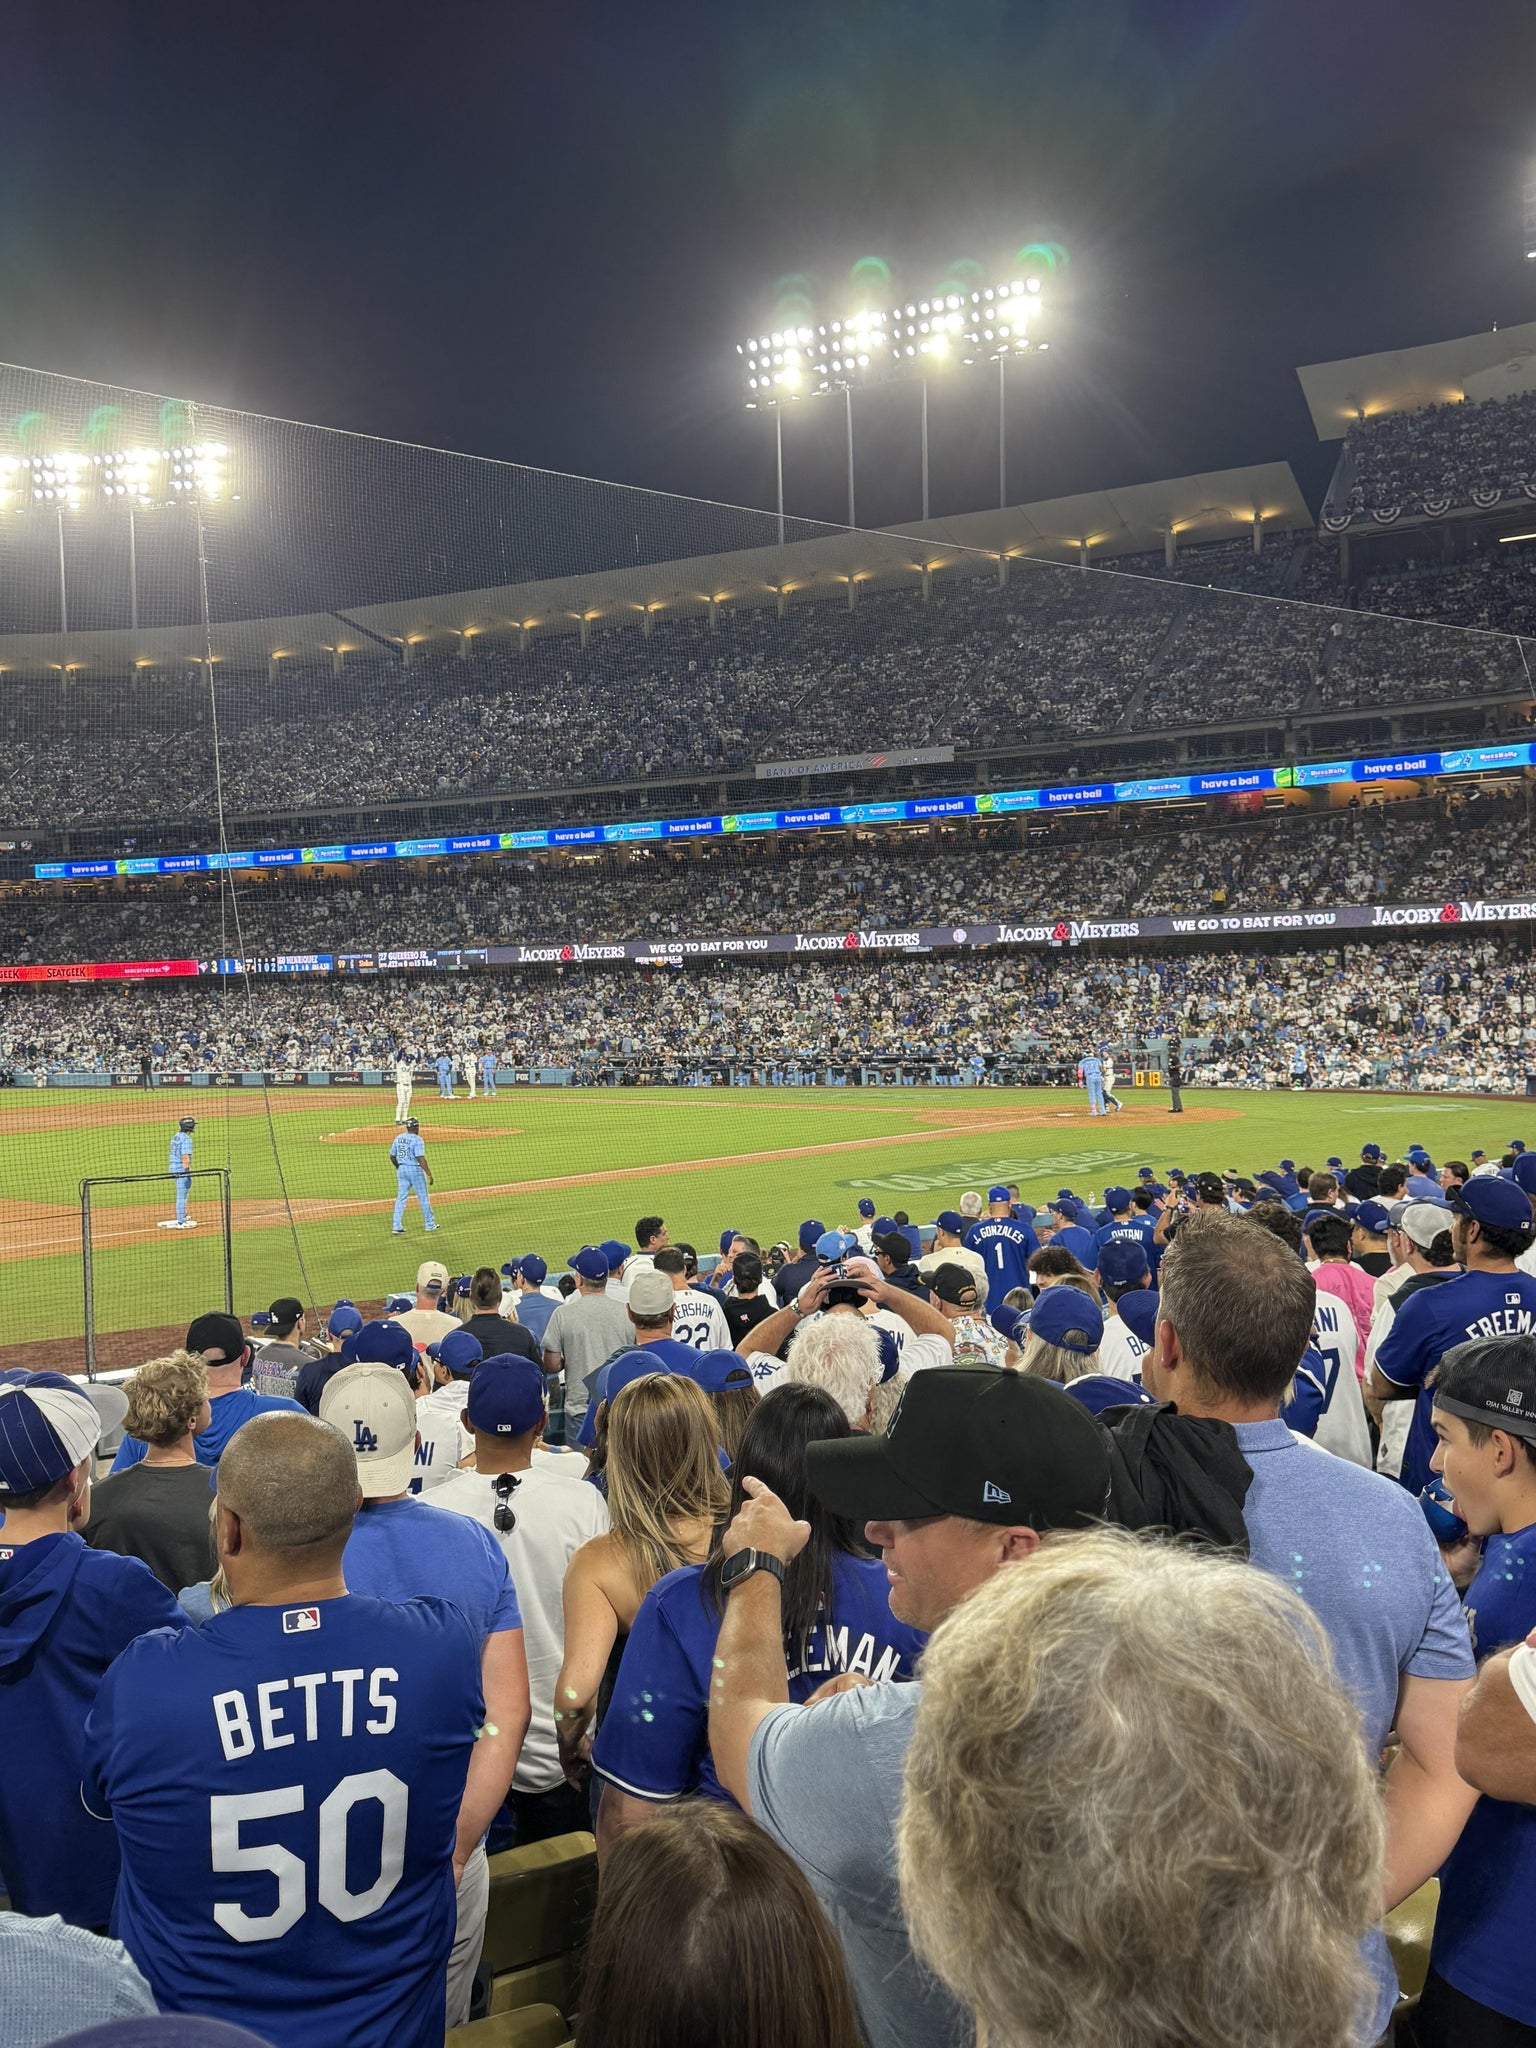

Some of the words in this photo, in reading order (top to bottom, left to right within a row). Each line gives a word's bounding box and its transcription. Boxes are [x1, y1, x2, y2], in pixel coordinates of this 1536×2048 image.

[766, 767, 795, 777] BANK
[797, 765, 811, 774] OF
[814, 760, 864, 773] AMERICA
[1365, 764, 1393, 774] have
[1403, 759, 1427, 771] ball
[1202, 780, 1229, 789] have
[1239, 775, 1259, 785] ball
[1049, 793, 1074, 801] have
[1082, 789, 1102, 798] ball
[915, 804, 938, 813] have
[946, 801, 964, 811] ball
[785, 815, 806, 823] have
[814, 812, 830, 821] ball
[696, 822, 711, 830] ball
[555, 833, 573, 841] have
[580, 831, 595, 839] ball
[453, 841, 470, 849] have
[1172, 919, 1196, 932] WE
[1197, 918, 1219, 930] GO
[1220, 918, 1241, 929] TO
[1242, 916, 1272, 929] BAT
[1273, 915, 1303, 927] FOR
[1304, 913, 1336, 925] YOU
[649, 944, 667, 954] WE
[667, 943, 684, 953] GO
[685, 942, 699, 952] TO
[701, 941, 722, 951] BAT
[723, 940, 745, 950] FOR
[745, 939, 768, 949] YOU
[388, 951, 419, 960] GUERRERO
[47, 966, 87, 978] SEATGEEK
[211, 960, 218, 973] 3
[263, 962, 270, 973] 0
[271, 962, 276, 972] 2
[516, 1073, 530, 1081] FOX
[980, 1225, 1024, 1244] GONZALES
[994, 1242, 1004, 1269] 1
[1485, 1399, 1500, 1409] OJAI
[1500, 1403, 1525, 1416] VALLEY
[353, 1419, 378, 1452] LA
[212, 1667, 399, 1762] BETTS
[210, 1768, 409, 1943] 50
